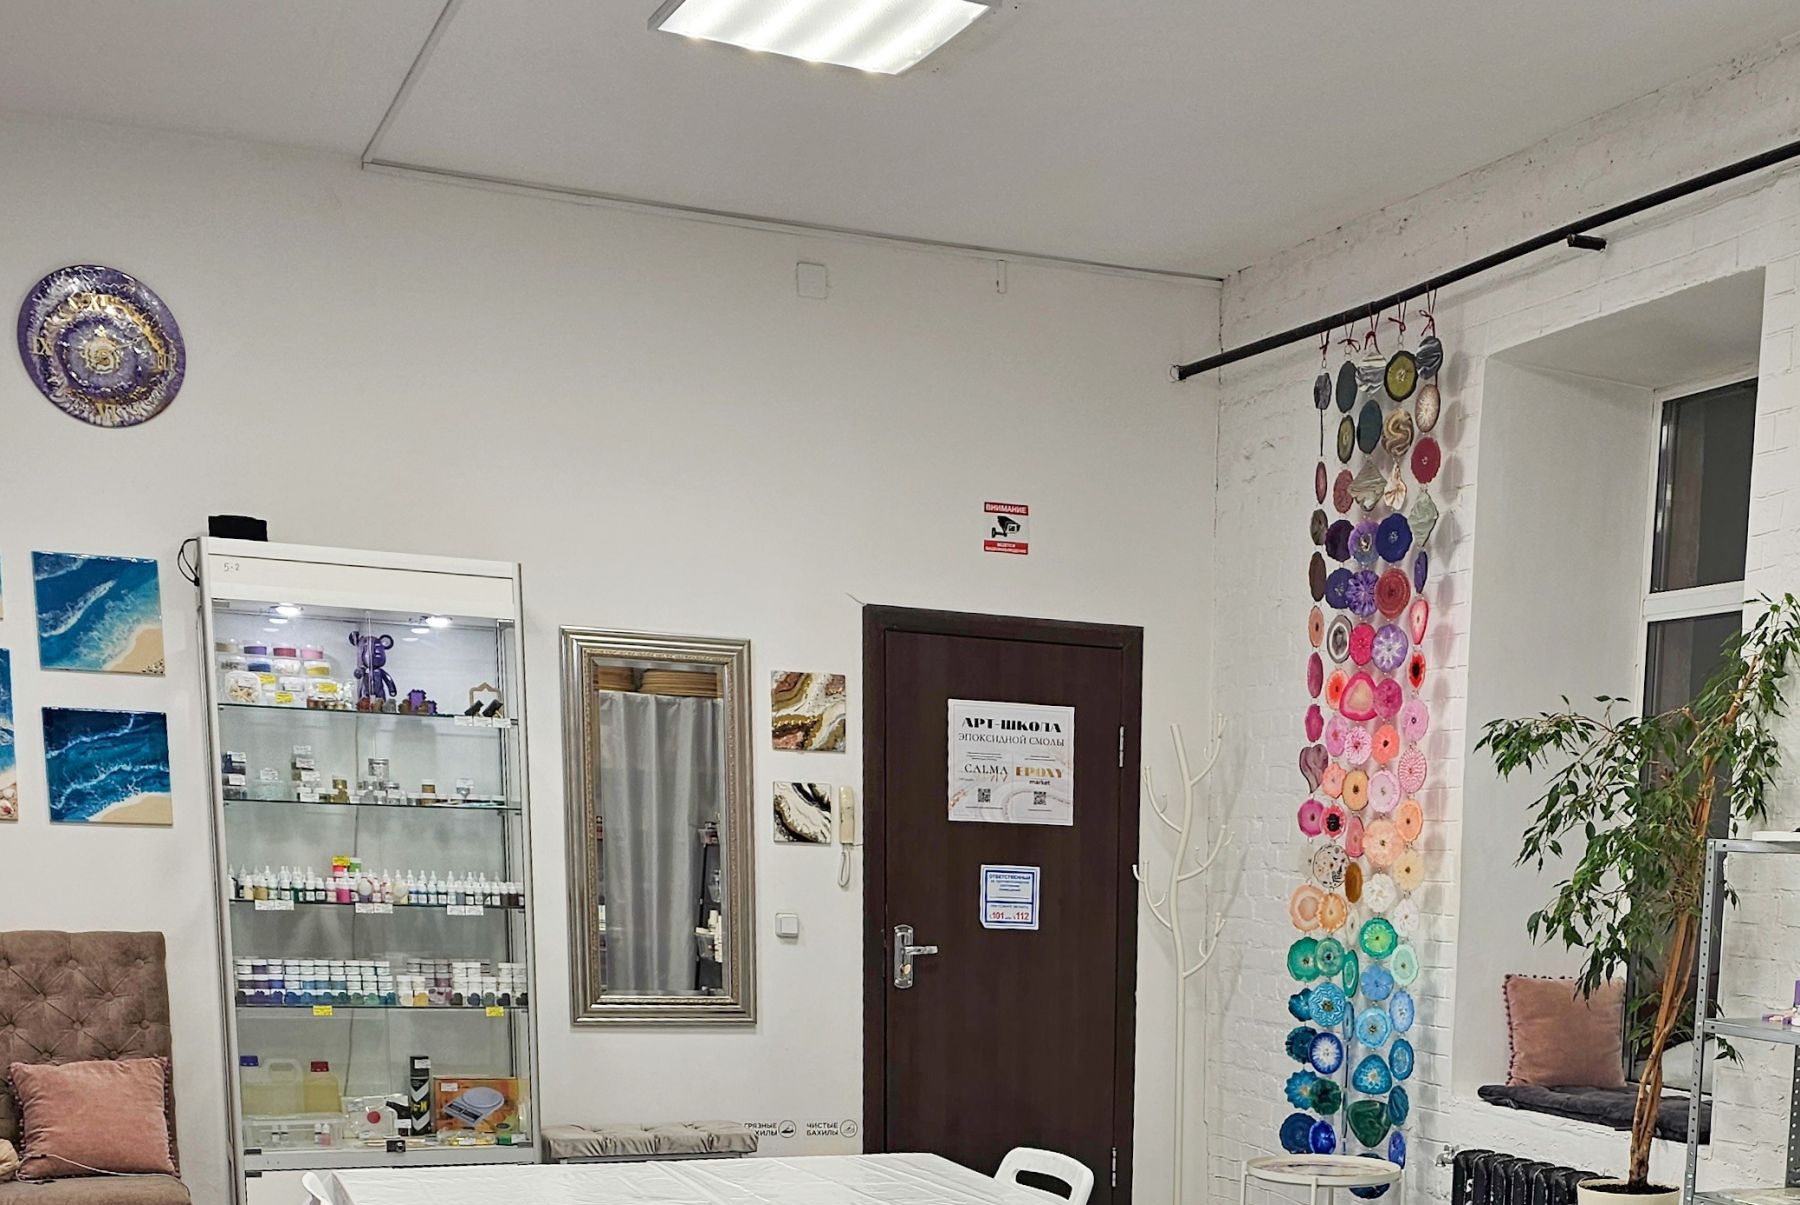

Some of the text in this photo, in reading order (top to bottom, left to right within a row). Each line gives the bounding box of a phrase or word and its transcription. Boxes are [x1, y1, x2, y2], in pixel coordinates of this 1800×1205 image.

[986, 503, 1027, 514] ВНИМАНИЕ
[961, 717, 1062, 733] АРТ-ШКОЛА
[958, 733, 1064, 747] ЭПОКСИДНОЙ СМОЛЫ
[964, 763, 1008, 775] CALMA
[1015, 767, 1062, 778] EPOXY
[1016, 912, 1030, 920] 112
